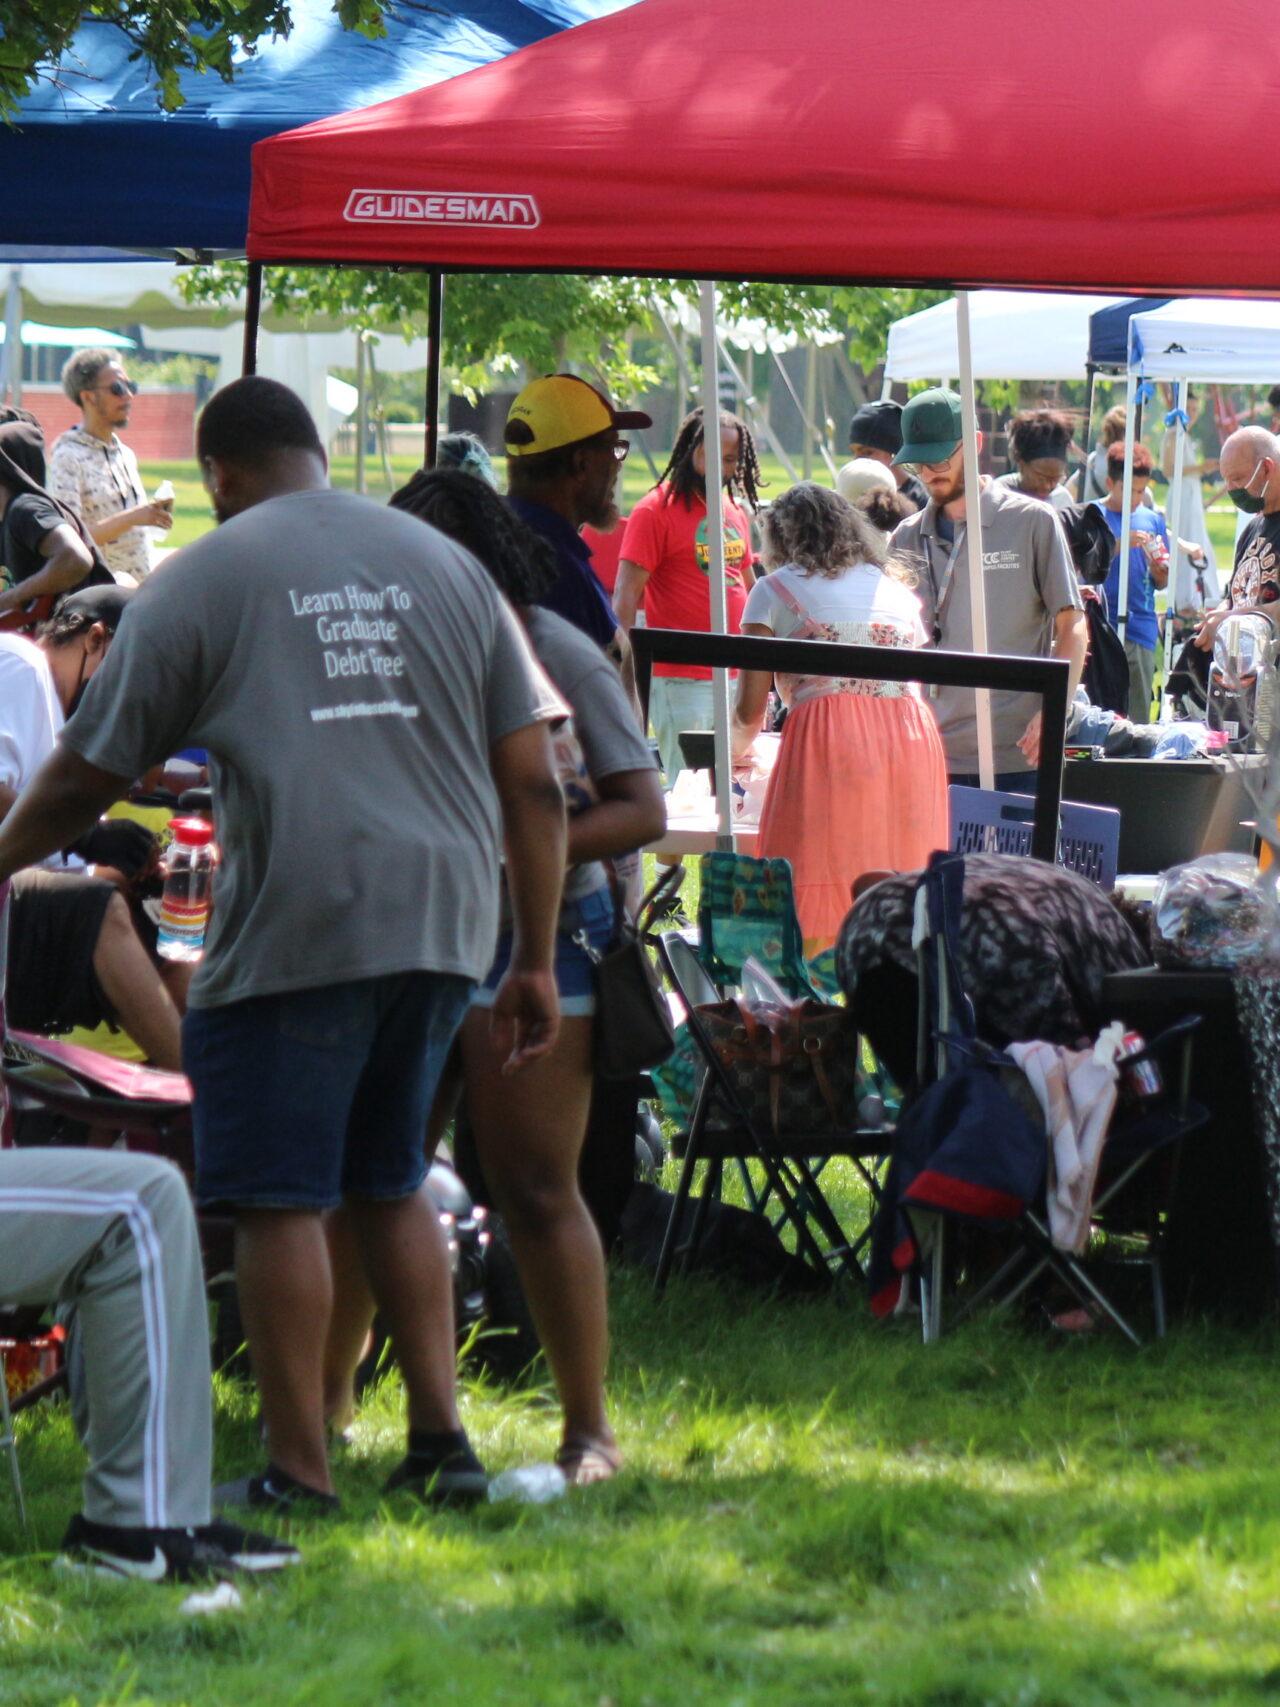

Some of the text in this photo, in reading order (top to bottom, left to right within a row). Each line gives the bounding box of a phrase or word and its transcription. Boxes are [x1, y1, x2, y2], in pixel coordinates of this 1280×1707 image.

[353, 195, 529, 223] GUIDESMAN
[288, 585, 411, 616] Learn How To
[316, 613, 398, 643] Graduate
[324, 648, 404, 678] Debt Free
